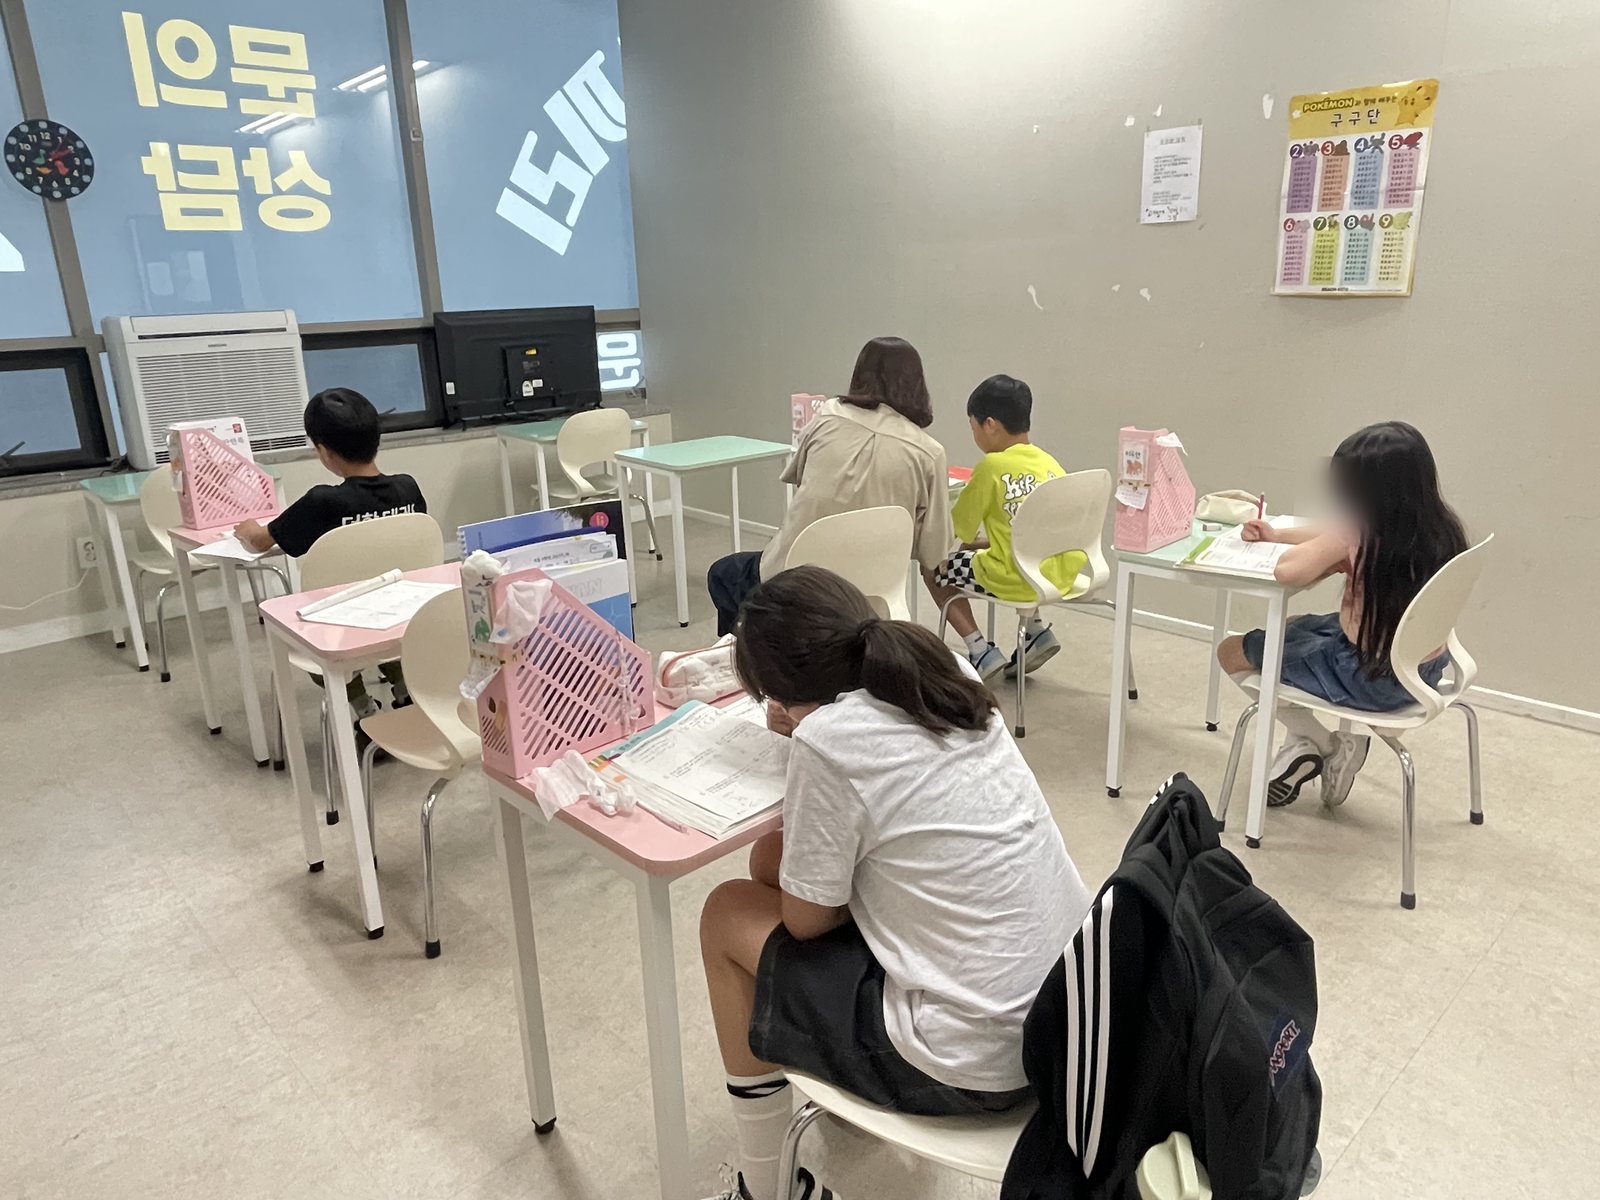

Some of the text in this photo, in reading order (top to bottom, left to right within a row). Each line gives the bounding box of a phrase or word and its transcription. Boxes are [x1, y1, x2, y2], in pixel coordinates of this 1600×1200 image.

[1331, 108, 1380, 128] 구구단
[27, 134, 38, 143] 11
[40, 131, 51, 140] 12
[19, 142, 32, 151] 10
